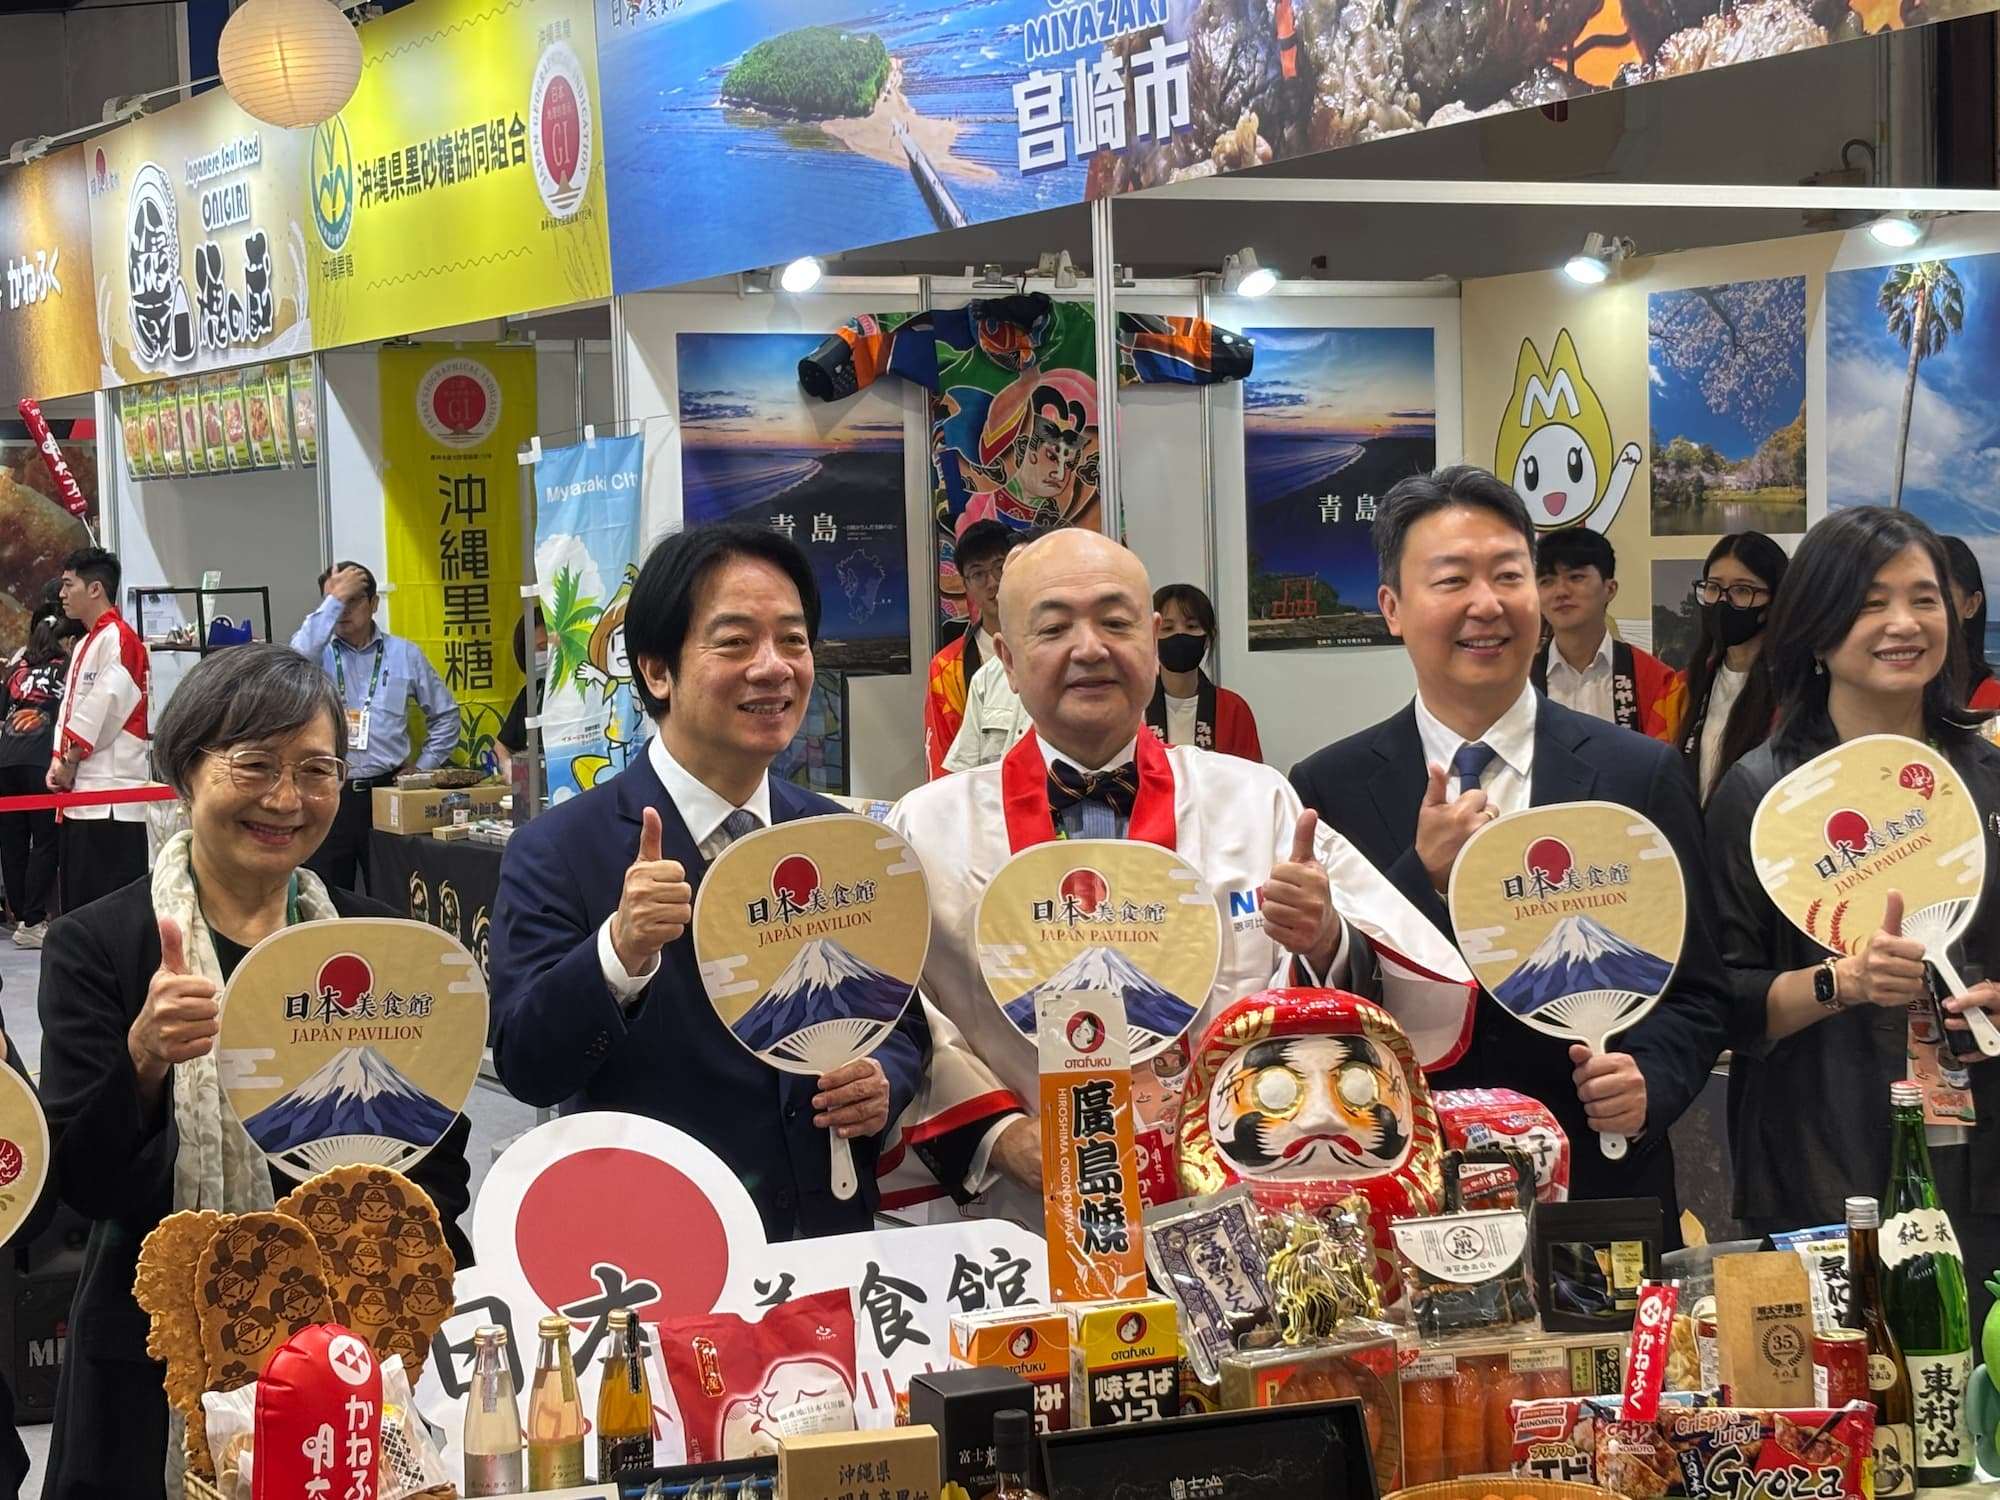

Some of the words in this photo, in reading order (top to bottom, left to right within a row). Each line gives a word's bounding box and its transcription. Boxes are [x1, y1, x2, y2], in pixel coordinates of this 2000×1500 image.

[1025, 0, 1169, 62] MIYAZAKI
[1012, 36, 1190, 172] 宮崎市
[357, 111, 526, 208] 沖縄県黒砂糖協同組合
[551, 120, 571, 167] GI
[203, 183, 249, 229] ONIGIRI
[7, 246, 62, 310] かねふく
[1317, 492, 1378, 524] 青島
[768, 511, 839, 545] 青島
[437, 471, 494, 692] 沖縄黒糖
[1814, 808, 1926, 879] 日本美食館
[1503, 864, 1631, 899] 日本美食館
[1834, 865, 1874, 895] JAPAN
[1874, 833, 1932, 872] PAVILION
[749, 880, 878, 925] 日本美食館
[1032, 896, 1167, 926] 日本美食館
[1514, 901, 1558, 920] JAPAN
[1562, 891, 1628, 912] PAVILION
[758, 925, 802, 948] JAPAN
[806, 910, 873, 936] PAVILION
[1040, 930, 1085, 943] JAPAN
[1090, 930, 1160, 943] PAVILION
[285, 988, 435, 1024] 日本美食館
[290, 1027, 343, 1045] JAPAN
[347, 1025, 424, 1041] PAVILION
[1057, 1088, 1069, 1154] HIROSHIMA
[1897, 1220, 1952, 1246] 純米
[1773, 1334, 1793, 1351] 35
[1095, 1366, 1174, 1402] 焼そば
[1629, 1330, 1655, 1411] かねふく
[1676, 1412, 1730, 1438] Crispy
[1915, 1362, 1961, 1461] 東村山
[1710, 1422, 1760, 1448] Juicy!
[838, 1459, 892, 1487] 沖縄県
[1704, 1446, 1845, 1500] Gyoza
